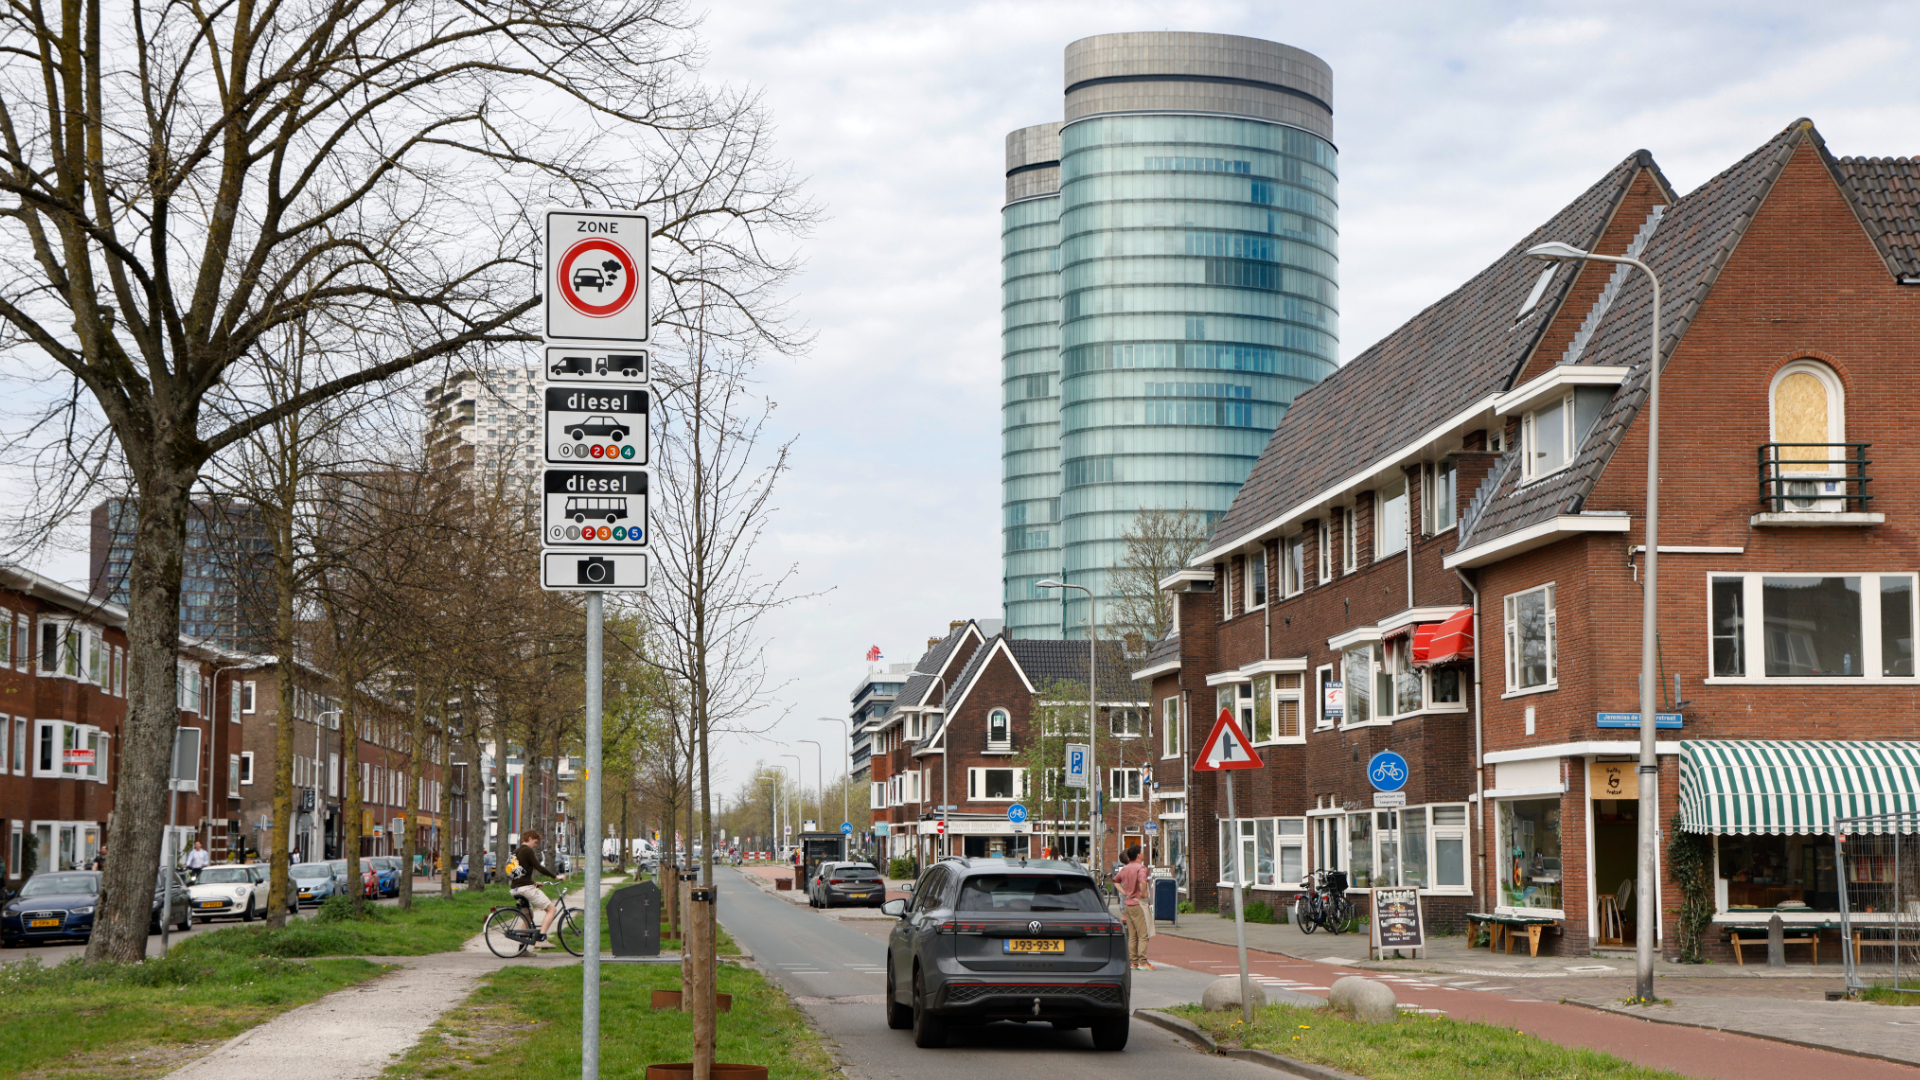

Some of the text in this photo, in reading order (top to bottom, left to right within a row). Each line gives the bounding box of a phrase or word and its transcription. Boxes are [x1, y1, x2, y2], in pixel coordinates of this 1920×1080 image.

[577, 221, 619, 234] ZONE
[567, 393, 628, 411] diesel
[562, 446, 632, 456] 0 1 2 3 4
[566, 475, 627, 492] diesel
[554, 529, 639, 538] 0 1 2 3 4 5
[1073, 752, 1081, 765] P
[1377, 890, 1415, 899] Pretzels
[1012, 940, 1060, 951] J93-93-X
